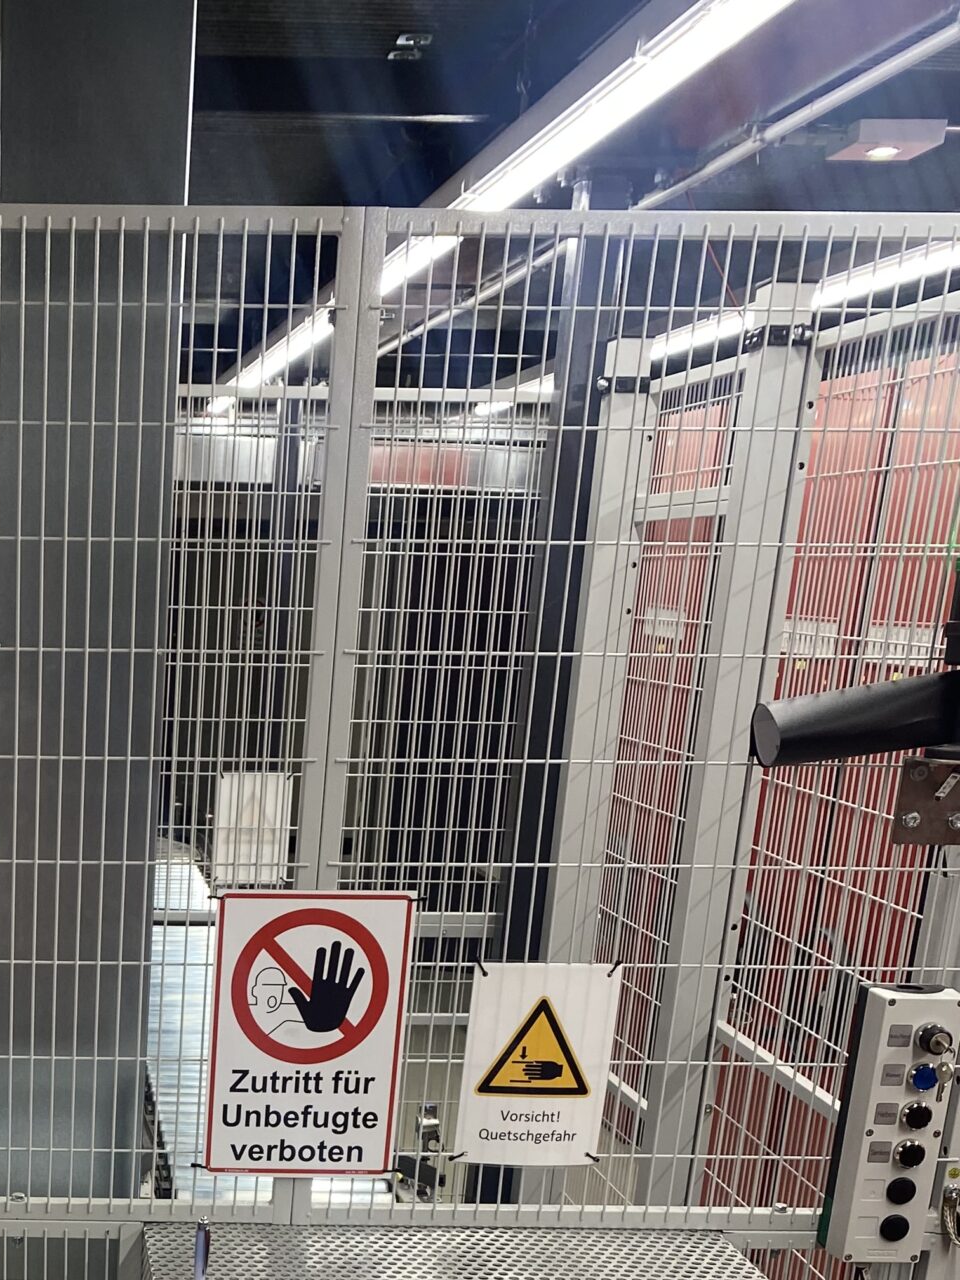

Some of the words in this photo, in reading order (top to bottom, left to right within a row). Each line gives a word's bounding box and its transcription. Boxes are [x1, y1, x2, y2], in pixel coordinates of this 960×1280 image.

[229, 1069, 324, 1094] Zutritt
[331, 1070, 376, 1095] für
[222, 1103, 379, 1135] Unbefugte
[500, 1110, 561, 1123] Vorsicht!
[478, 1128, 577, 1145] Quetschgefahr
[230, 1139, 363, 1163] verboten
